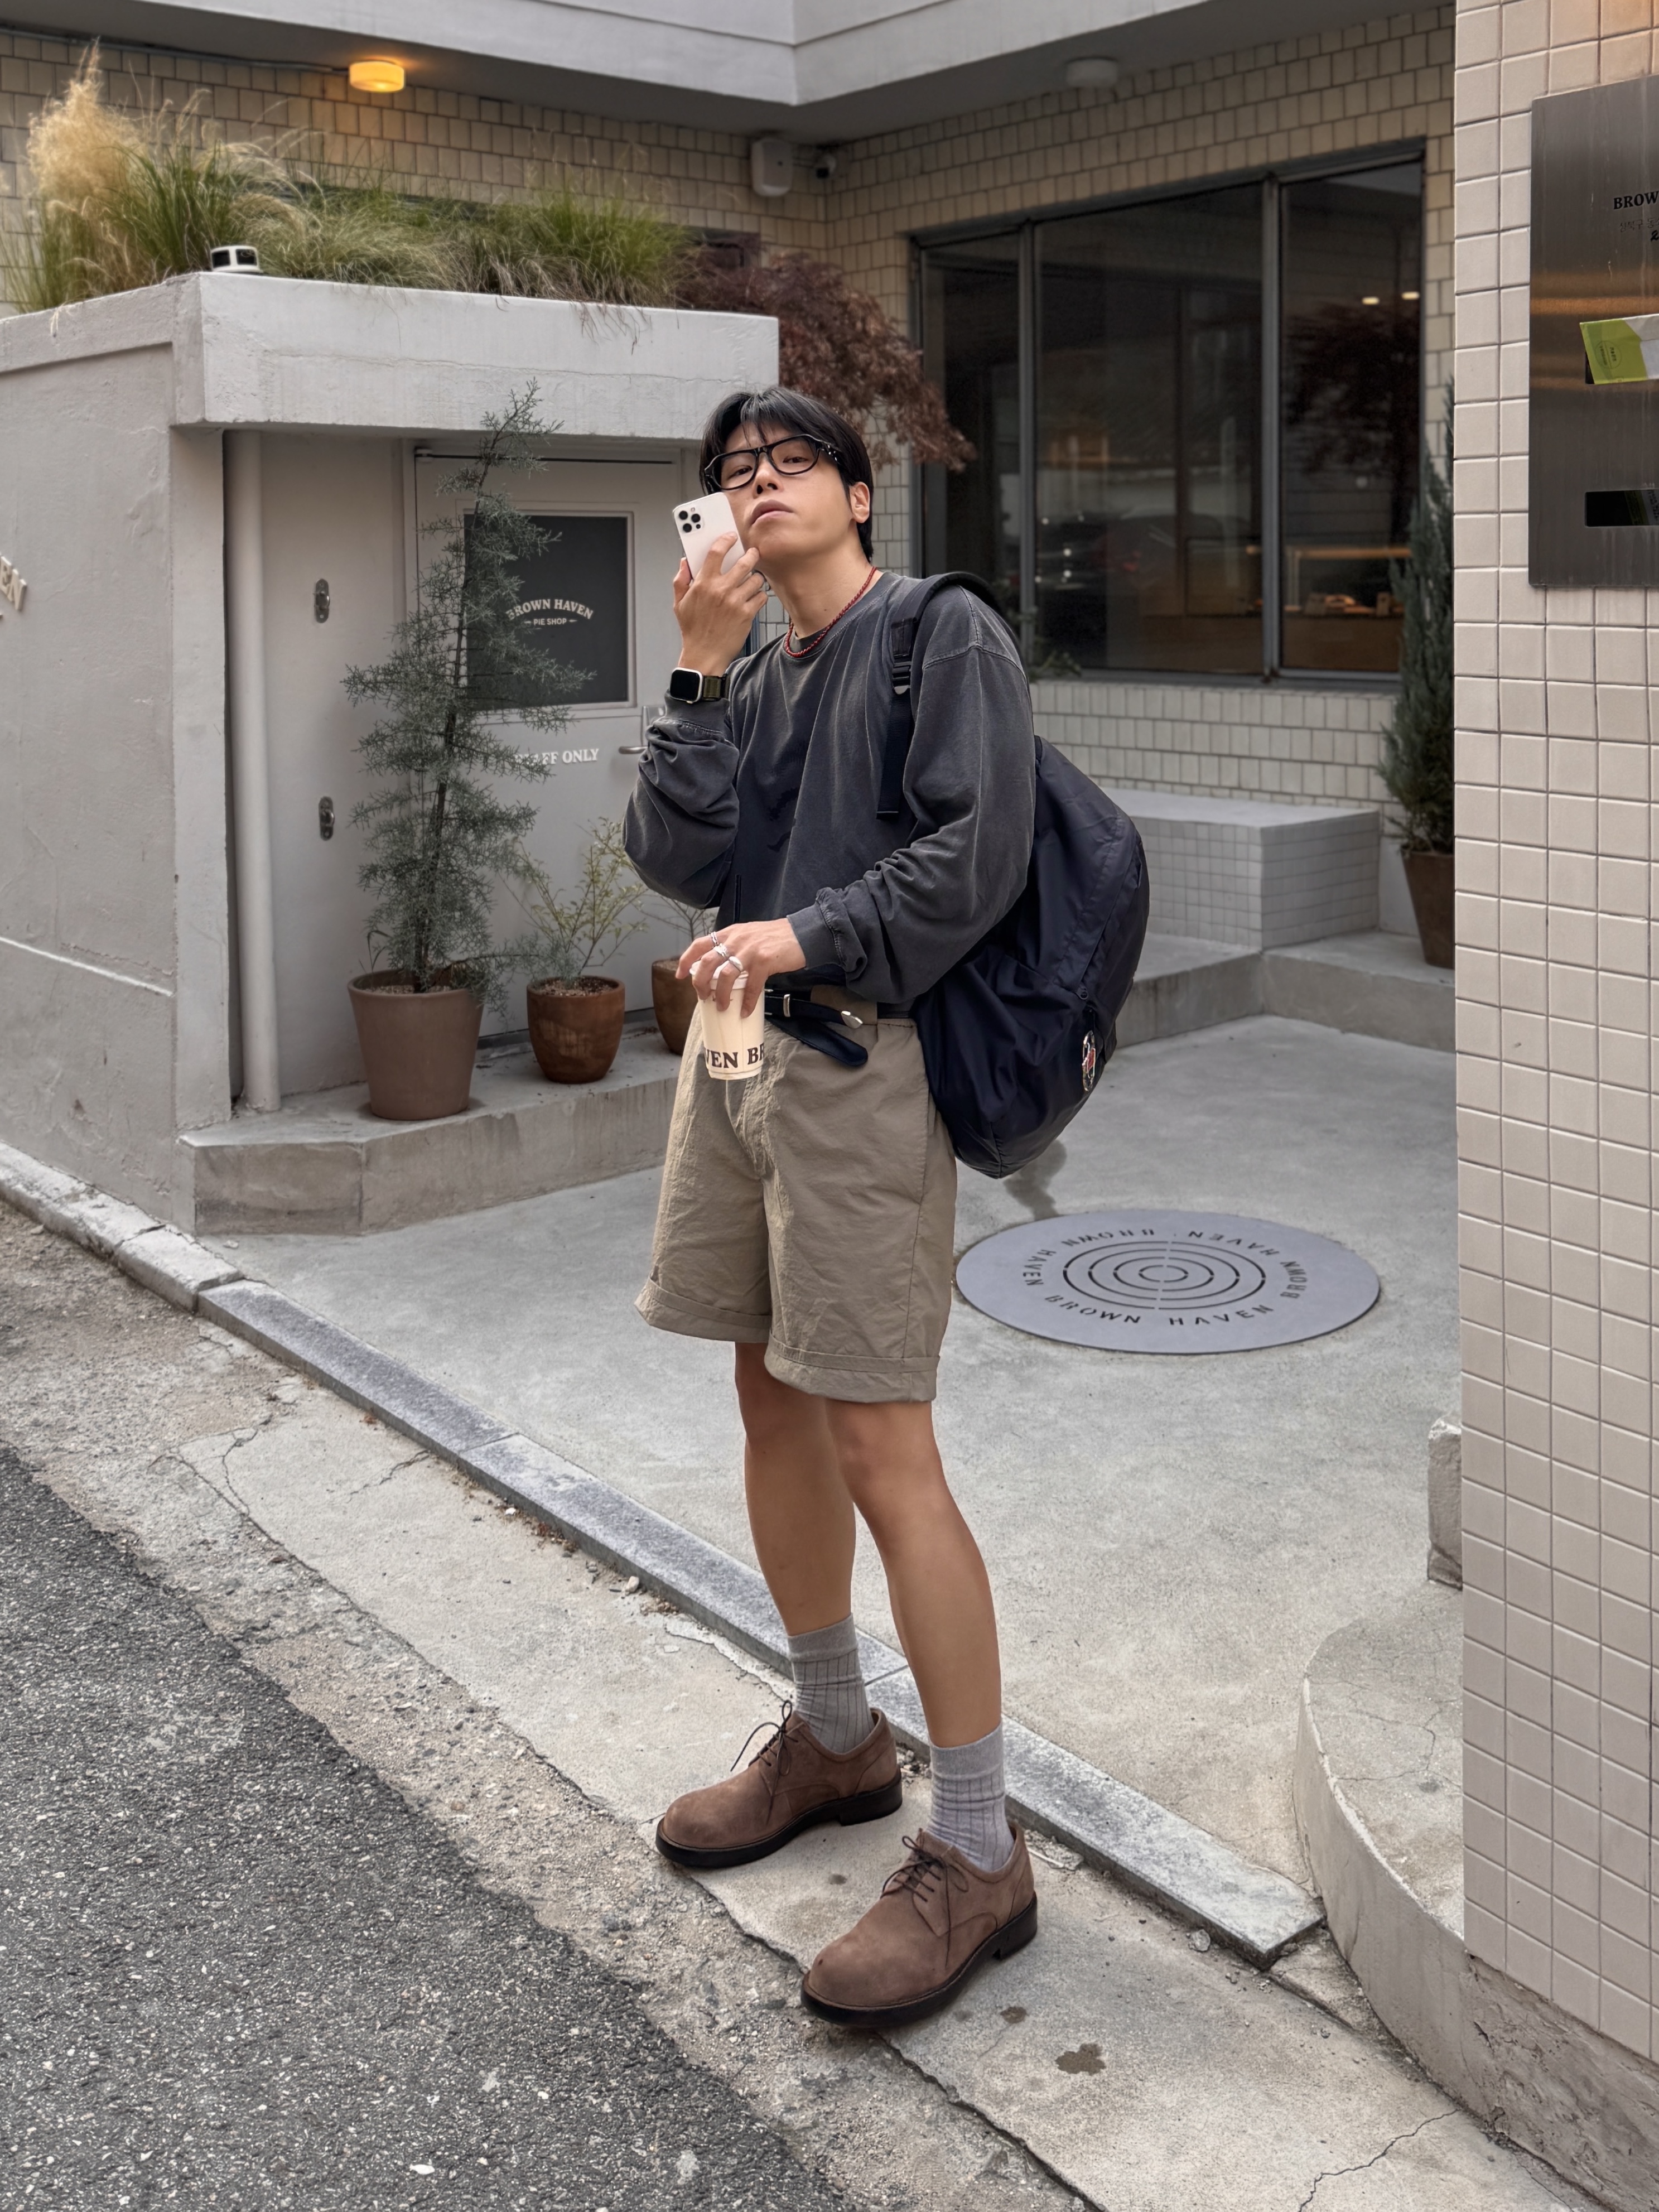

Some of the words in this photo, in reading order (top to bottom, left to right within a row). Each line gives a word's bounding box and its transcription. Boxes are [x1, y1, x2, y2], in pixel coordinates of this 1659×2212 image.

[1614, 191, 1659, 209] BROW
[0, 556, 27, 610] EN
[554, 599, 594, 620] HAVEN
[562, 748, 599, 764] ONLY
[1188, 1230, 1280, 1256] HAVEN
[1023, 1249, 1057, 1286] HAVEN
[1280, 1261, 1308, 1299] BROWN
[1045, 1295, 1141, 1324] BROWN
[1169, 1304, 1274, 1326] HAVEN
